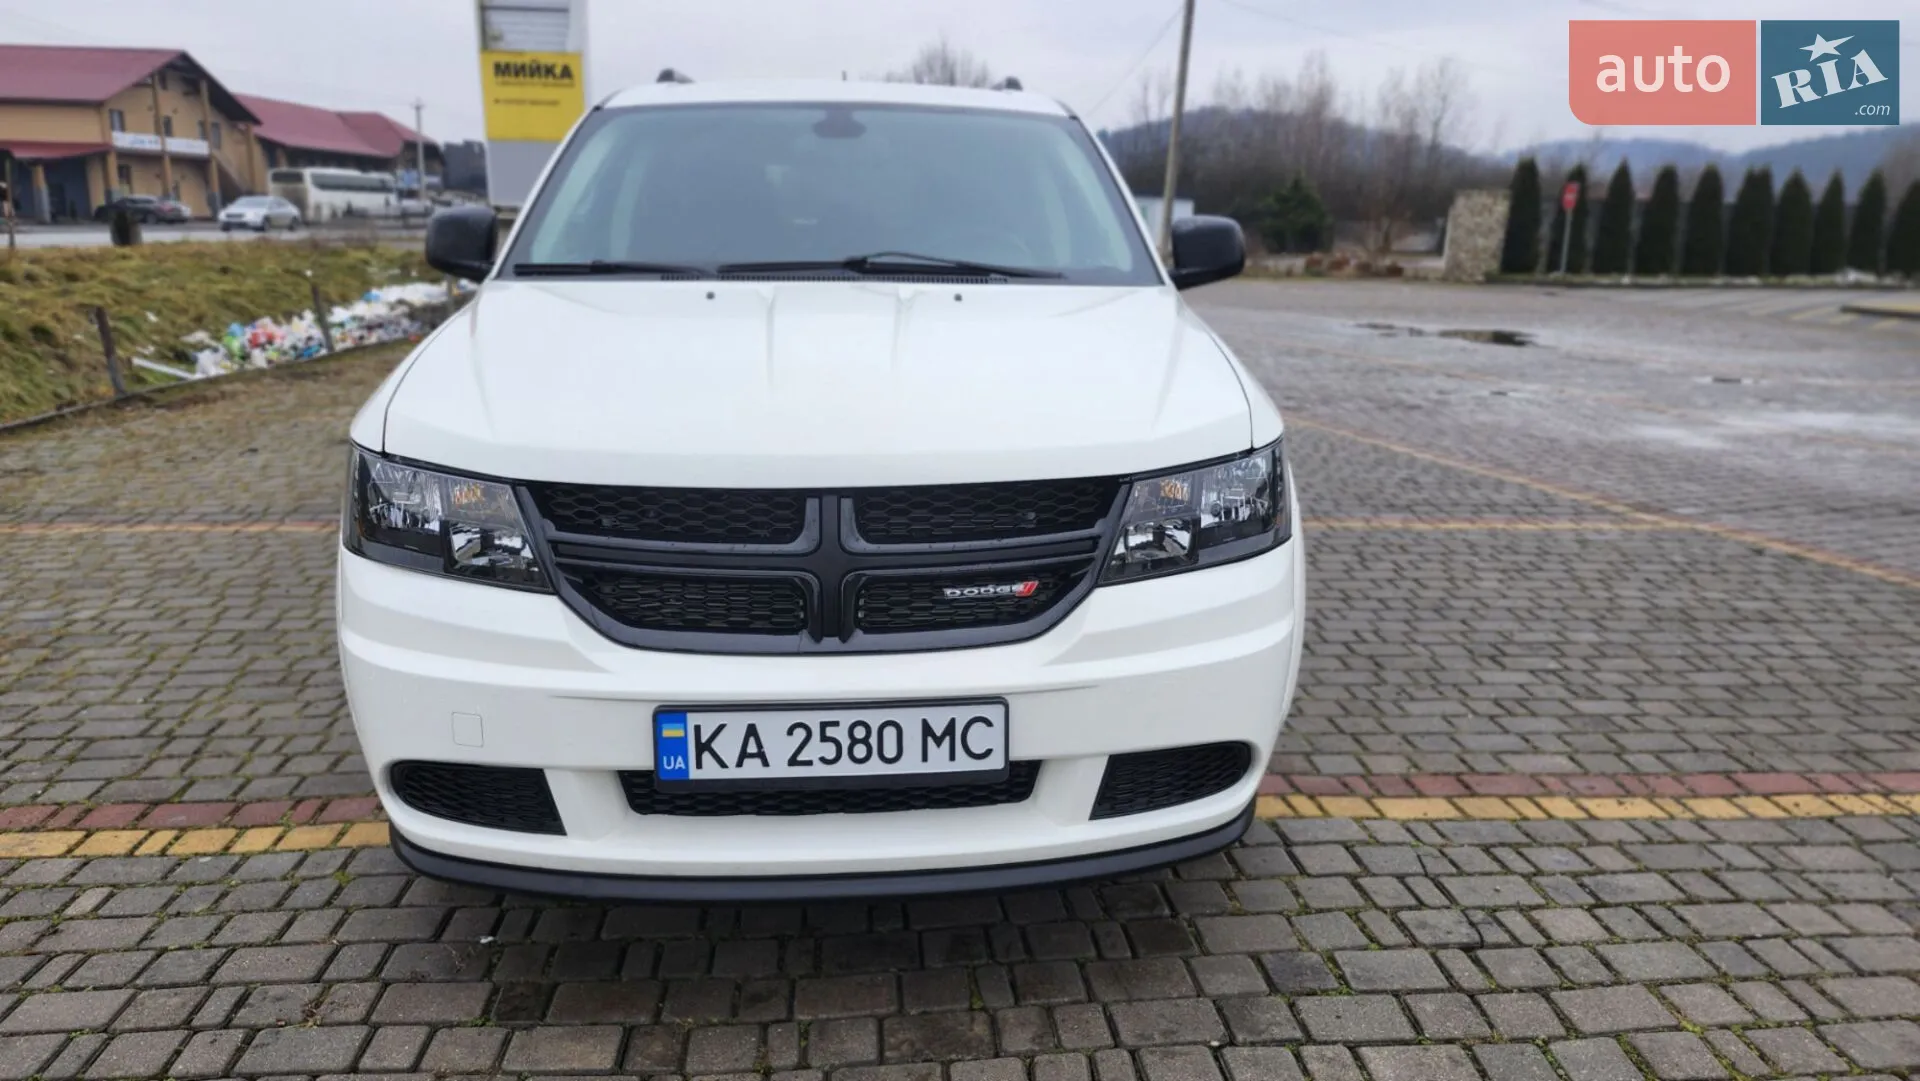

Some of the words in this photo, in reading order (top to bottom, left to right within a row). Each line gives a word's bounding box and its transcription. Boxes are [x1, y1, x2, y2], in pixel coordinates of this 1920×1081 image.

[494, 59, 573, 80] МИЙКА
[943, 584, 1026, 598] DODGE
[693, 723, 770, 770] KA
[786, 720, 904, 767] 2580
[921, 716, 994, 763] MC
[663, 755, 685, 770] UA
